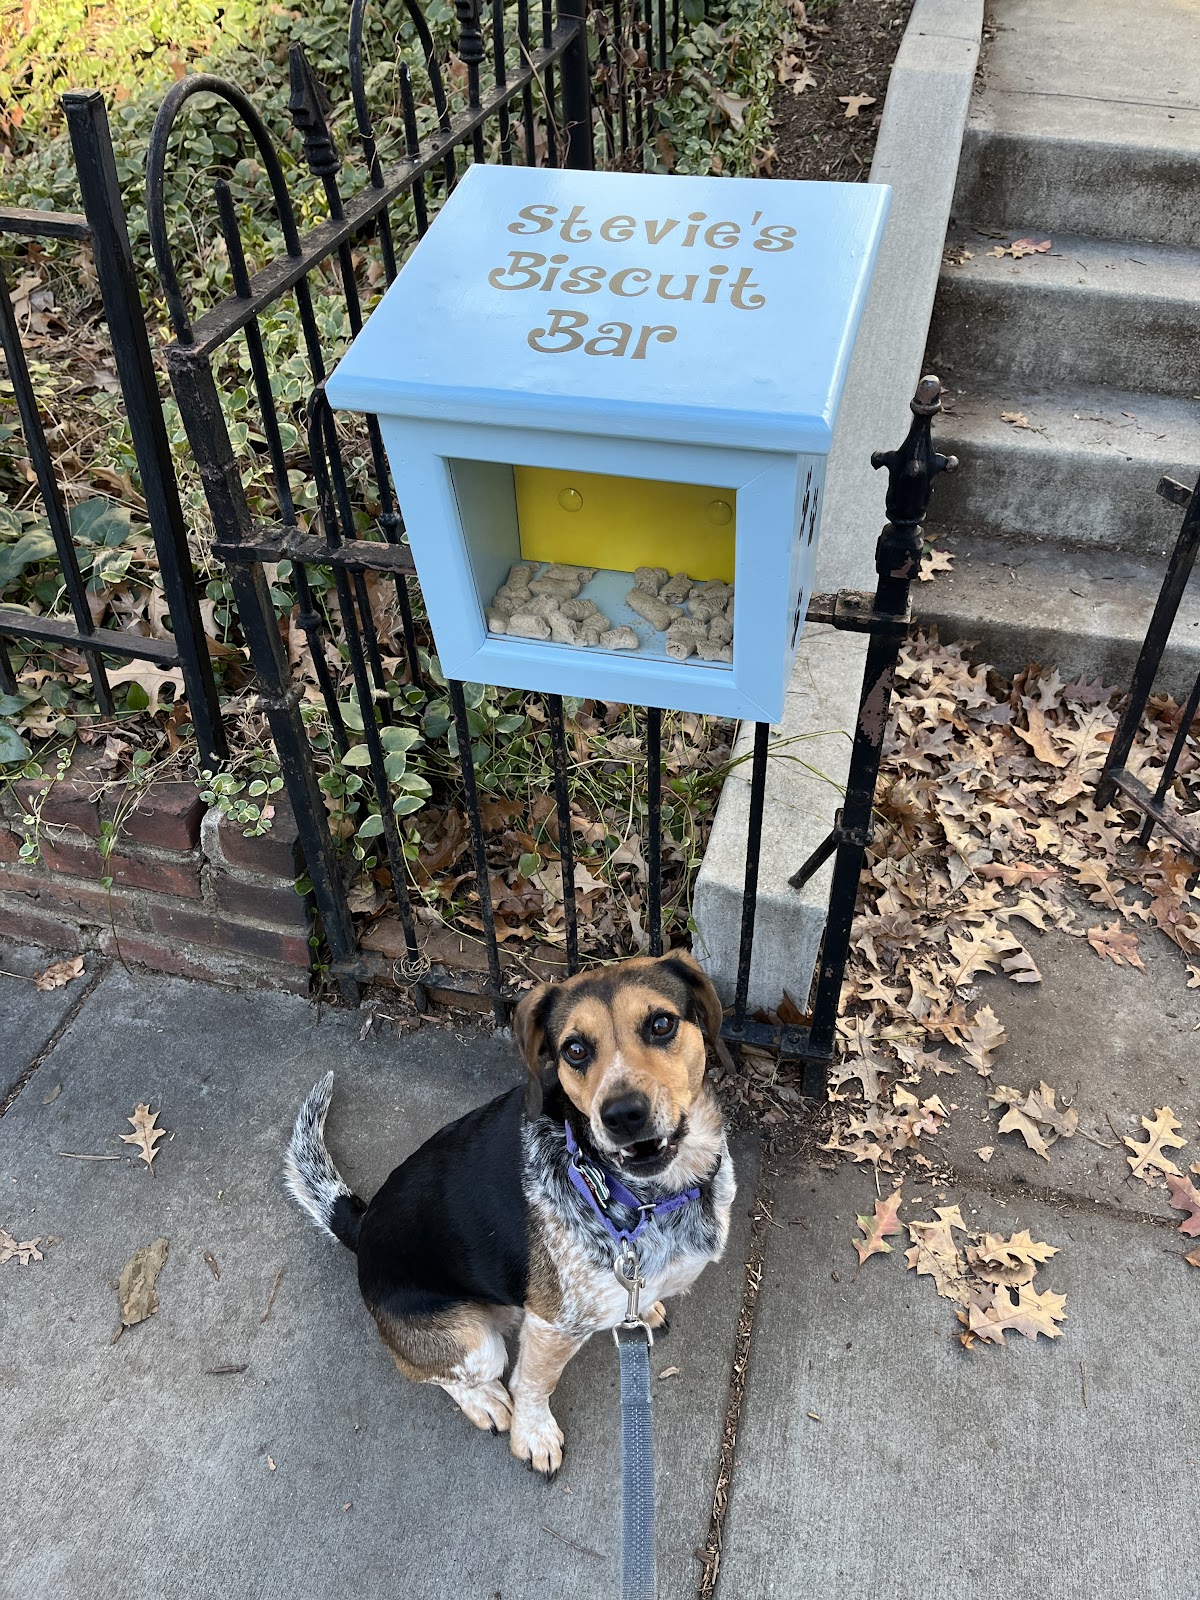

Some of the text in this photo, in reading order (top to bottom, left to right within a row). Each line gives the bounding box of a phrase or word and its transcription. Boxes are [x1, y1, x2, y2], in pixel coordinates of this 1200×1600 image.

[507, 204, 797, 252] Stevie's
[488, 250, 766, 310] Biscuit
[527, 309, 678, 359] Bar
